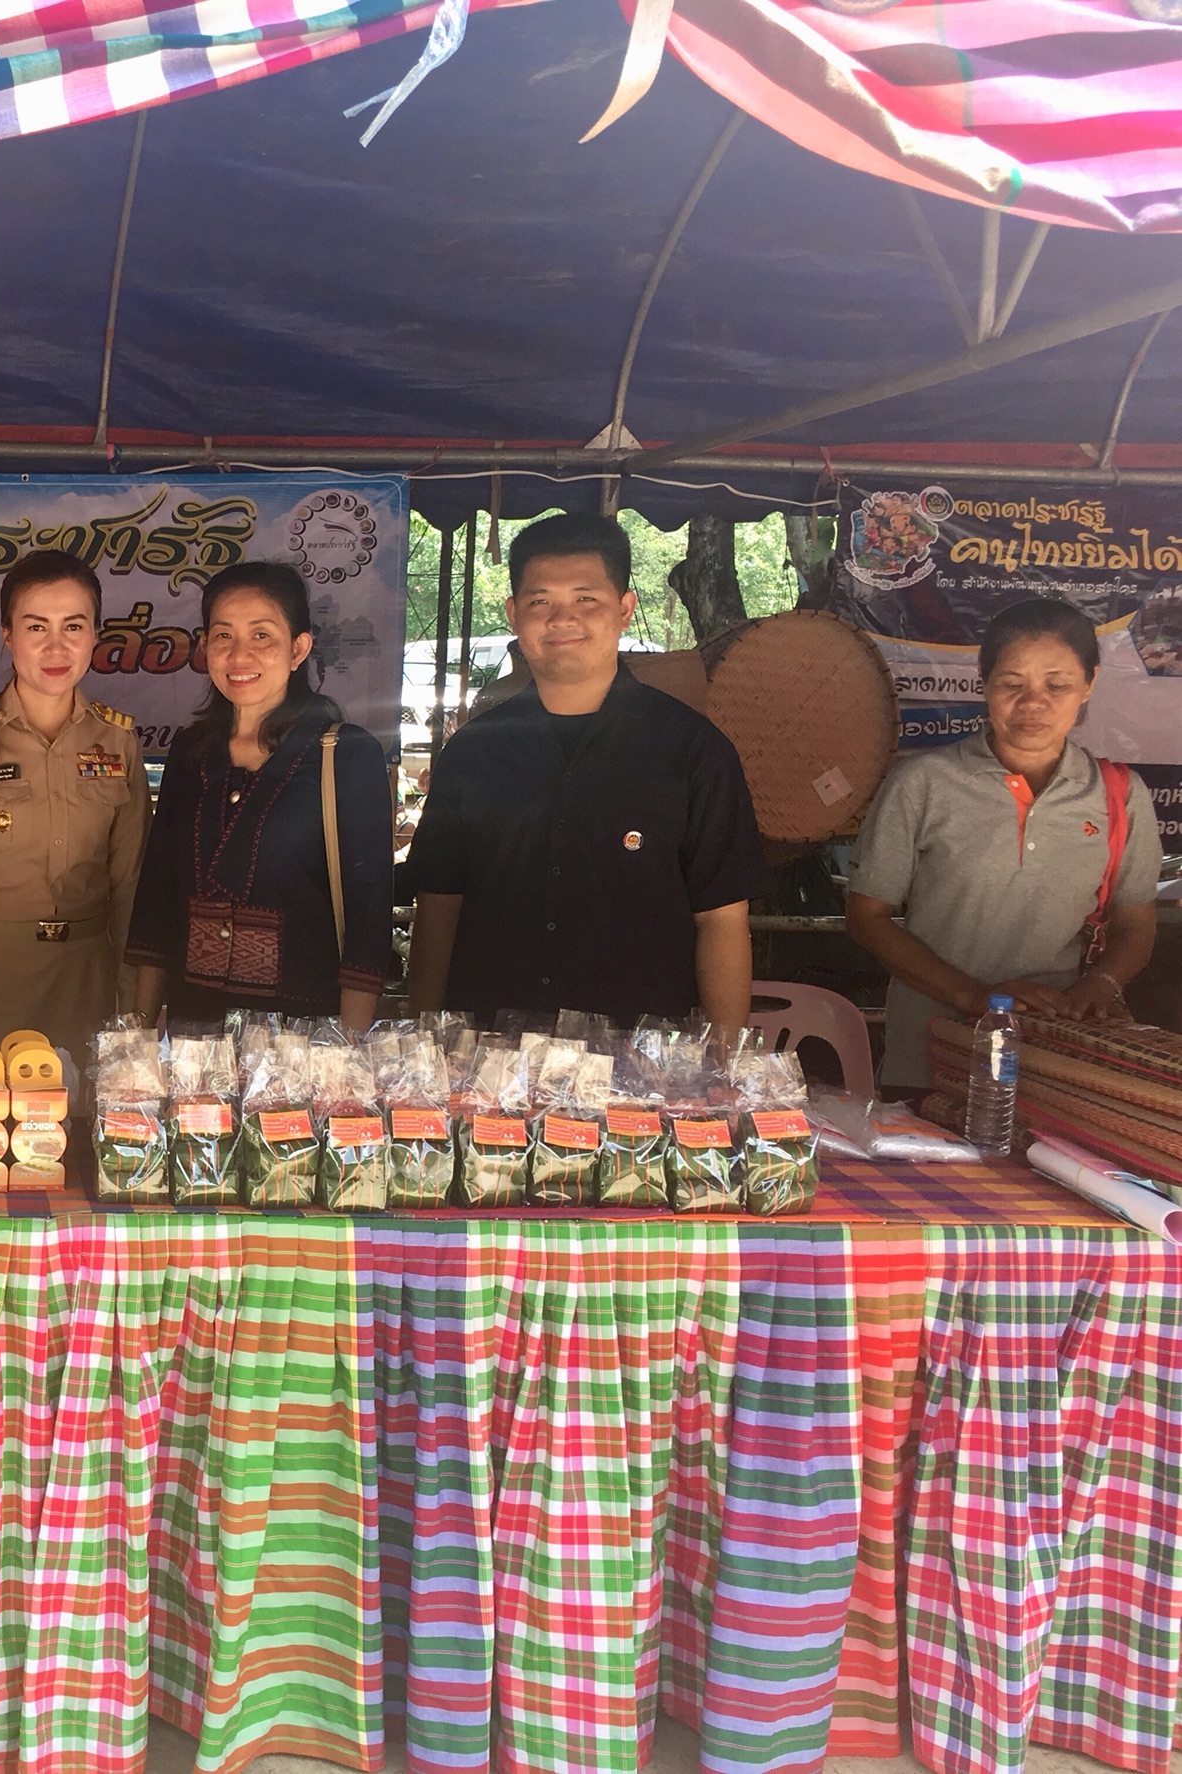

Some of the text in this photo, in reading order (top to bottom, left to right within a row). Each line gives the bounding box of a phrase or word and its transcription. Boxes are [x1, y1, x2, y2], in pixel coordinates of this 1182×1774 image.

[954, 497, 1106, 528] ตลาดประชารัฐ
[950, 523, 1182, 573] คนไทยยิ้มได้
[935, 571, 956, 588] โดย
